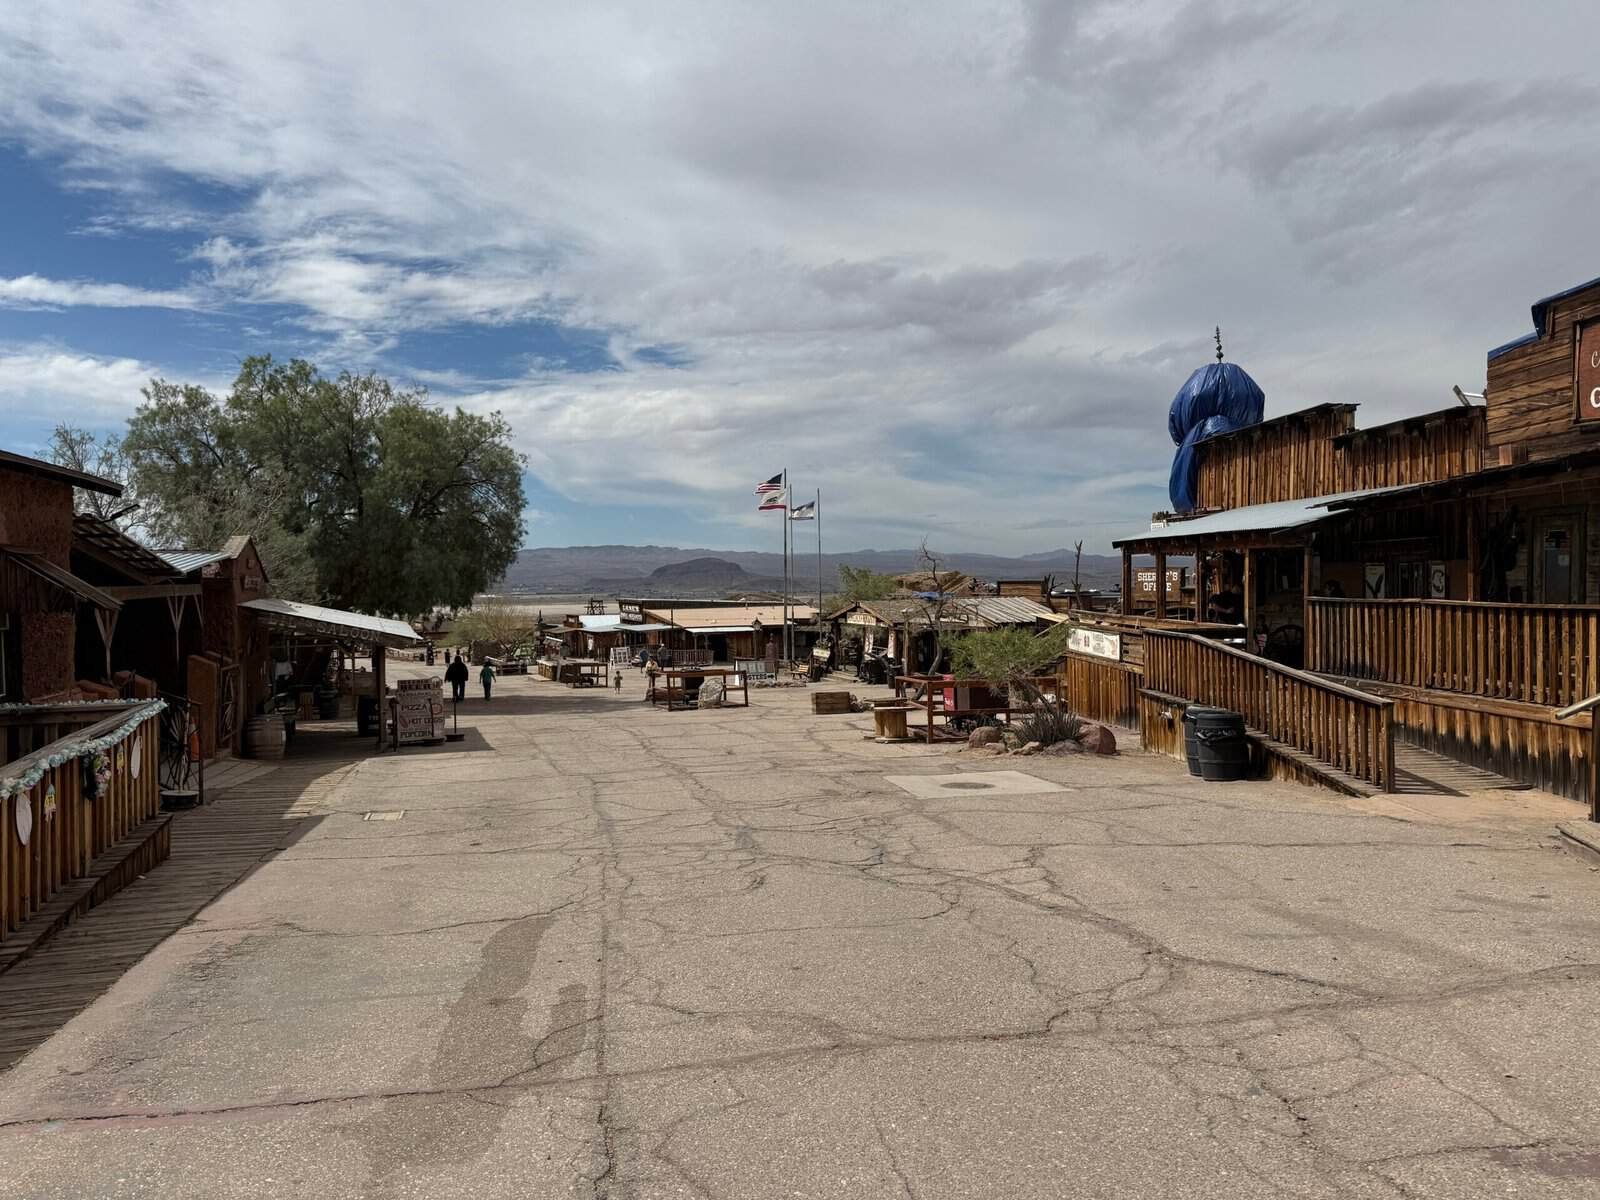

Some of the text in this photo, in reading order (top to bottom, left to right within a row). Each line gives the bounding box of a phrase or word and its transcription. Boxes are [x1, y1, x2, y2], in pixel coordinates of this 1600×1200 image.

[1137, 570, 1178, 581] SHERF'S
[1143, 582, 1172, 592] OFFE
[317, 622, 380, 641] SALOON
[401, 704, 427, 712] PIZZA
